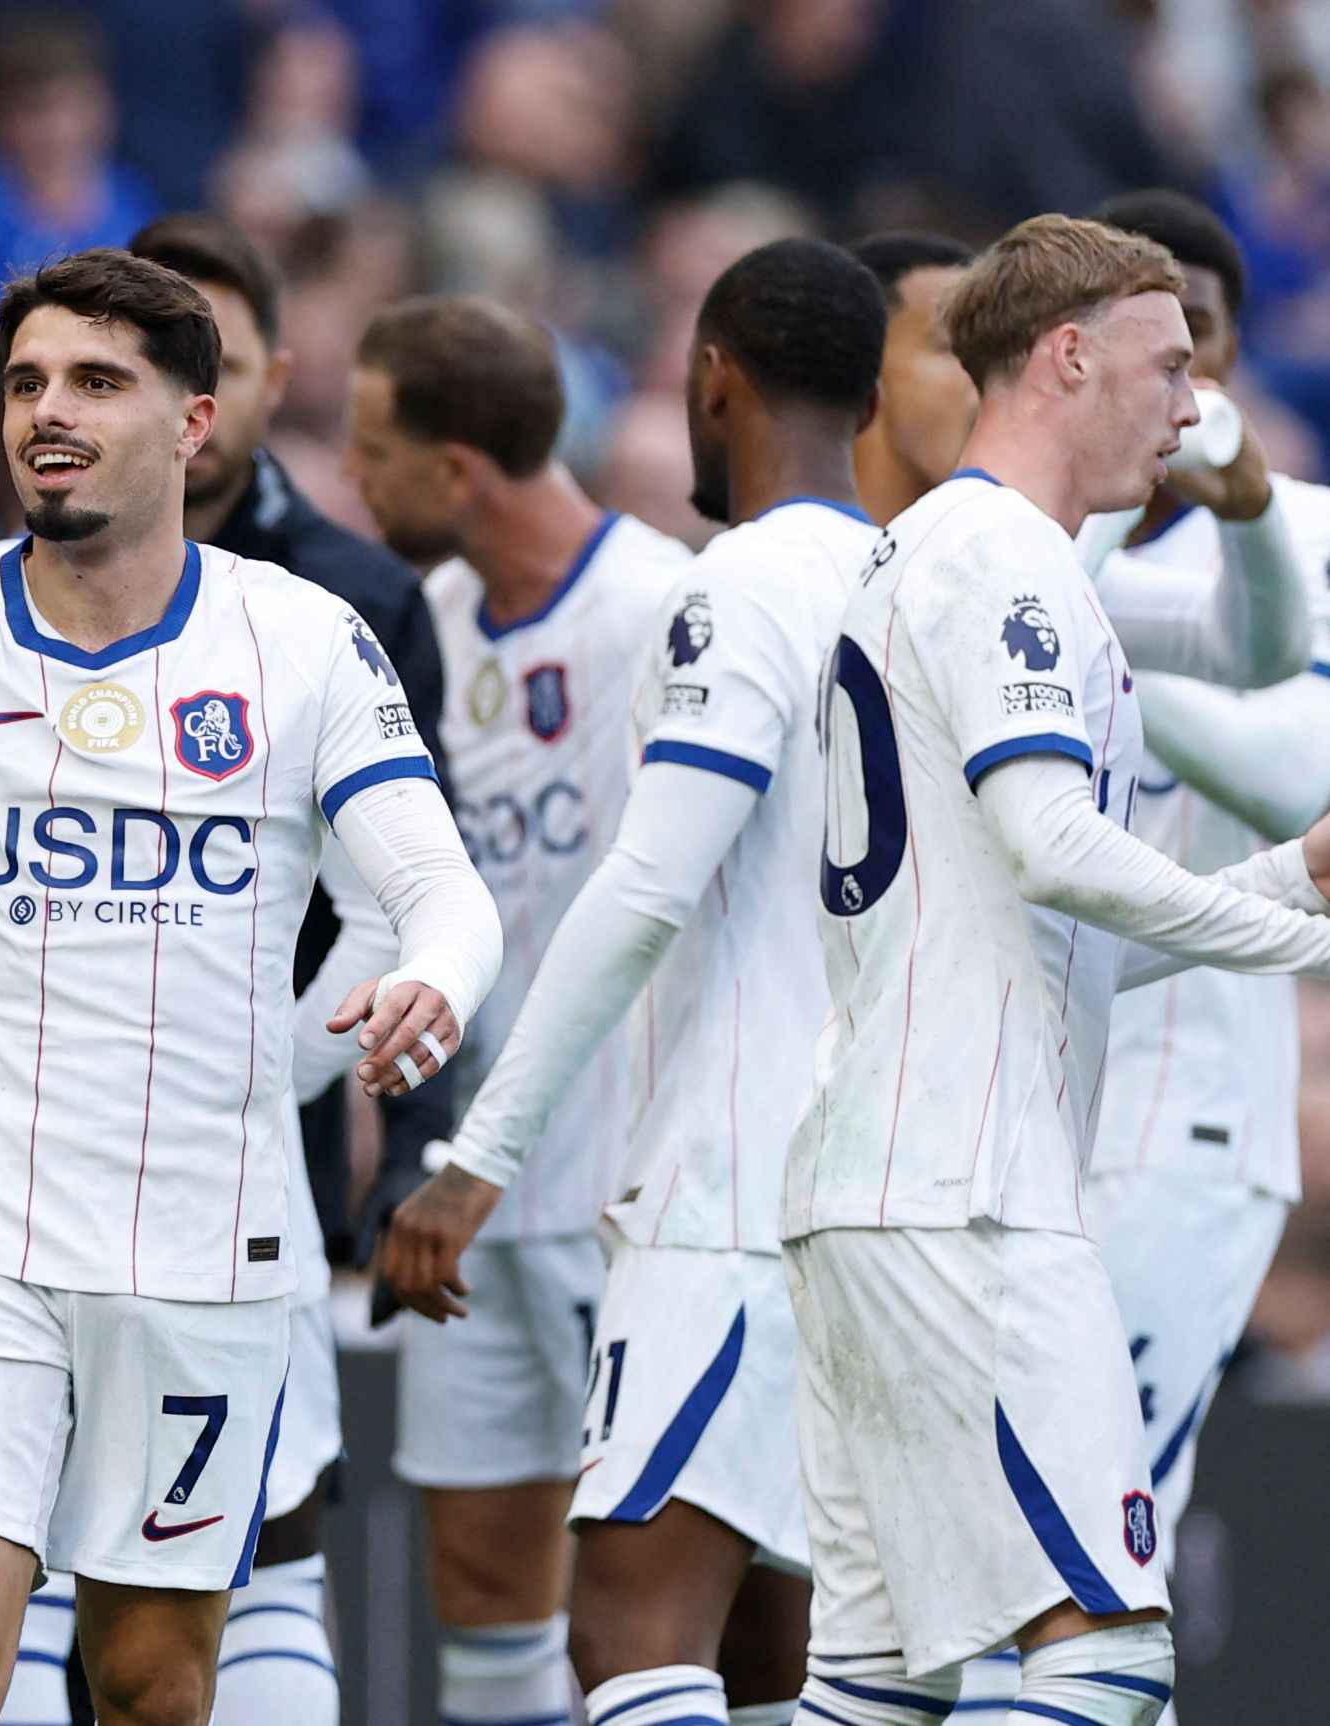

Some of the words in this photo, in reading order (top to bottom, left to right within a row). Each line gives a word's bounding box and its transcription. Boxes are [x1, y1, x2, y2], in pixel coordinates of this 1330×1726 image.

[999, 685, 1027, 701] No
[375, 706, 397, 723] No
[87, 738, 120, 749] FIFA
[816, 632, 908, 917] 0
[48, 901, 83, 922] BY
[94, 902, 204, 927] CIRCLE
[161, 1395, 228, 1505] 7
